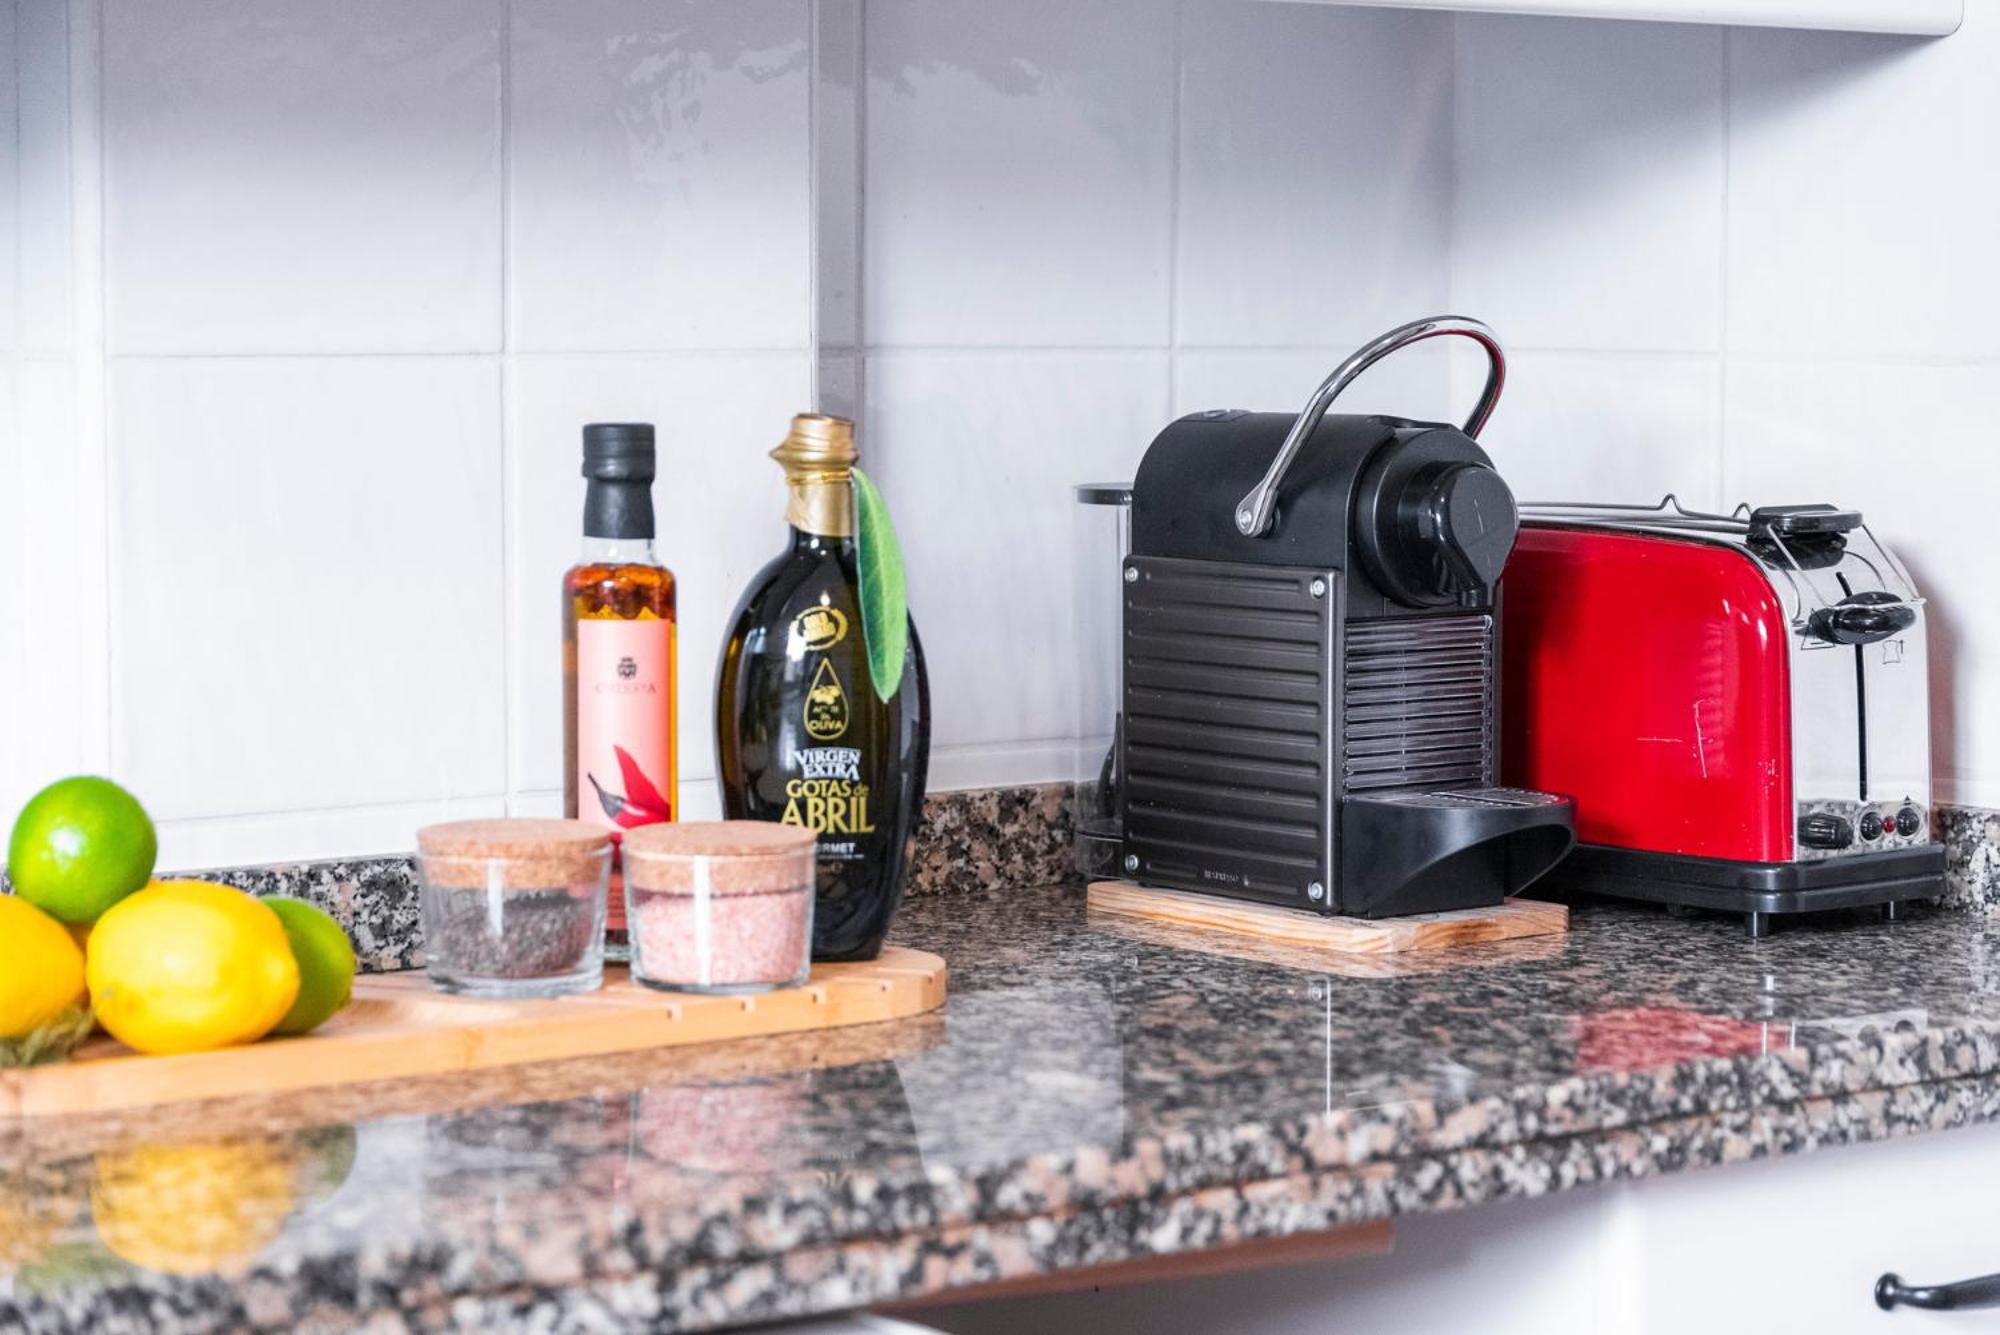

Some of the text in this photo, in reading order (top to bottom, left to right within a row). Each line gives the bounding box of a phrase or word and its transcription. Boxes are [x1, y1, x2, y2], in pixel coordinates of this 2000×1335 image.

[809, 720, 843, 730] OLIVA
[795, 748, 862, 765] VIRGEN
[803, 762, 860, 781] EXTRA
[785, 779, 869, 798] GOTAS de
[781, 796, 875, 833] ABRIL
